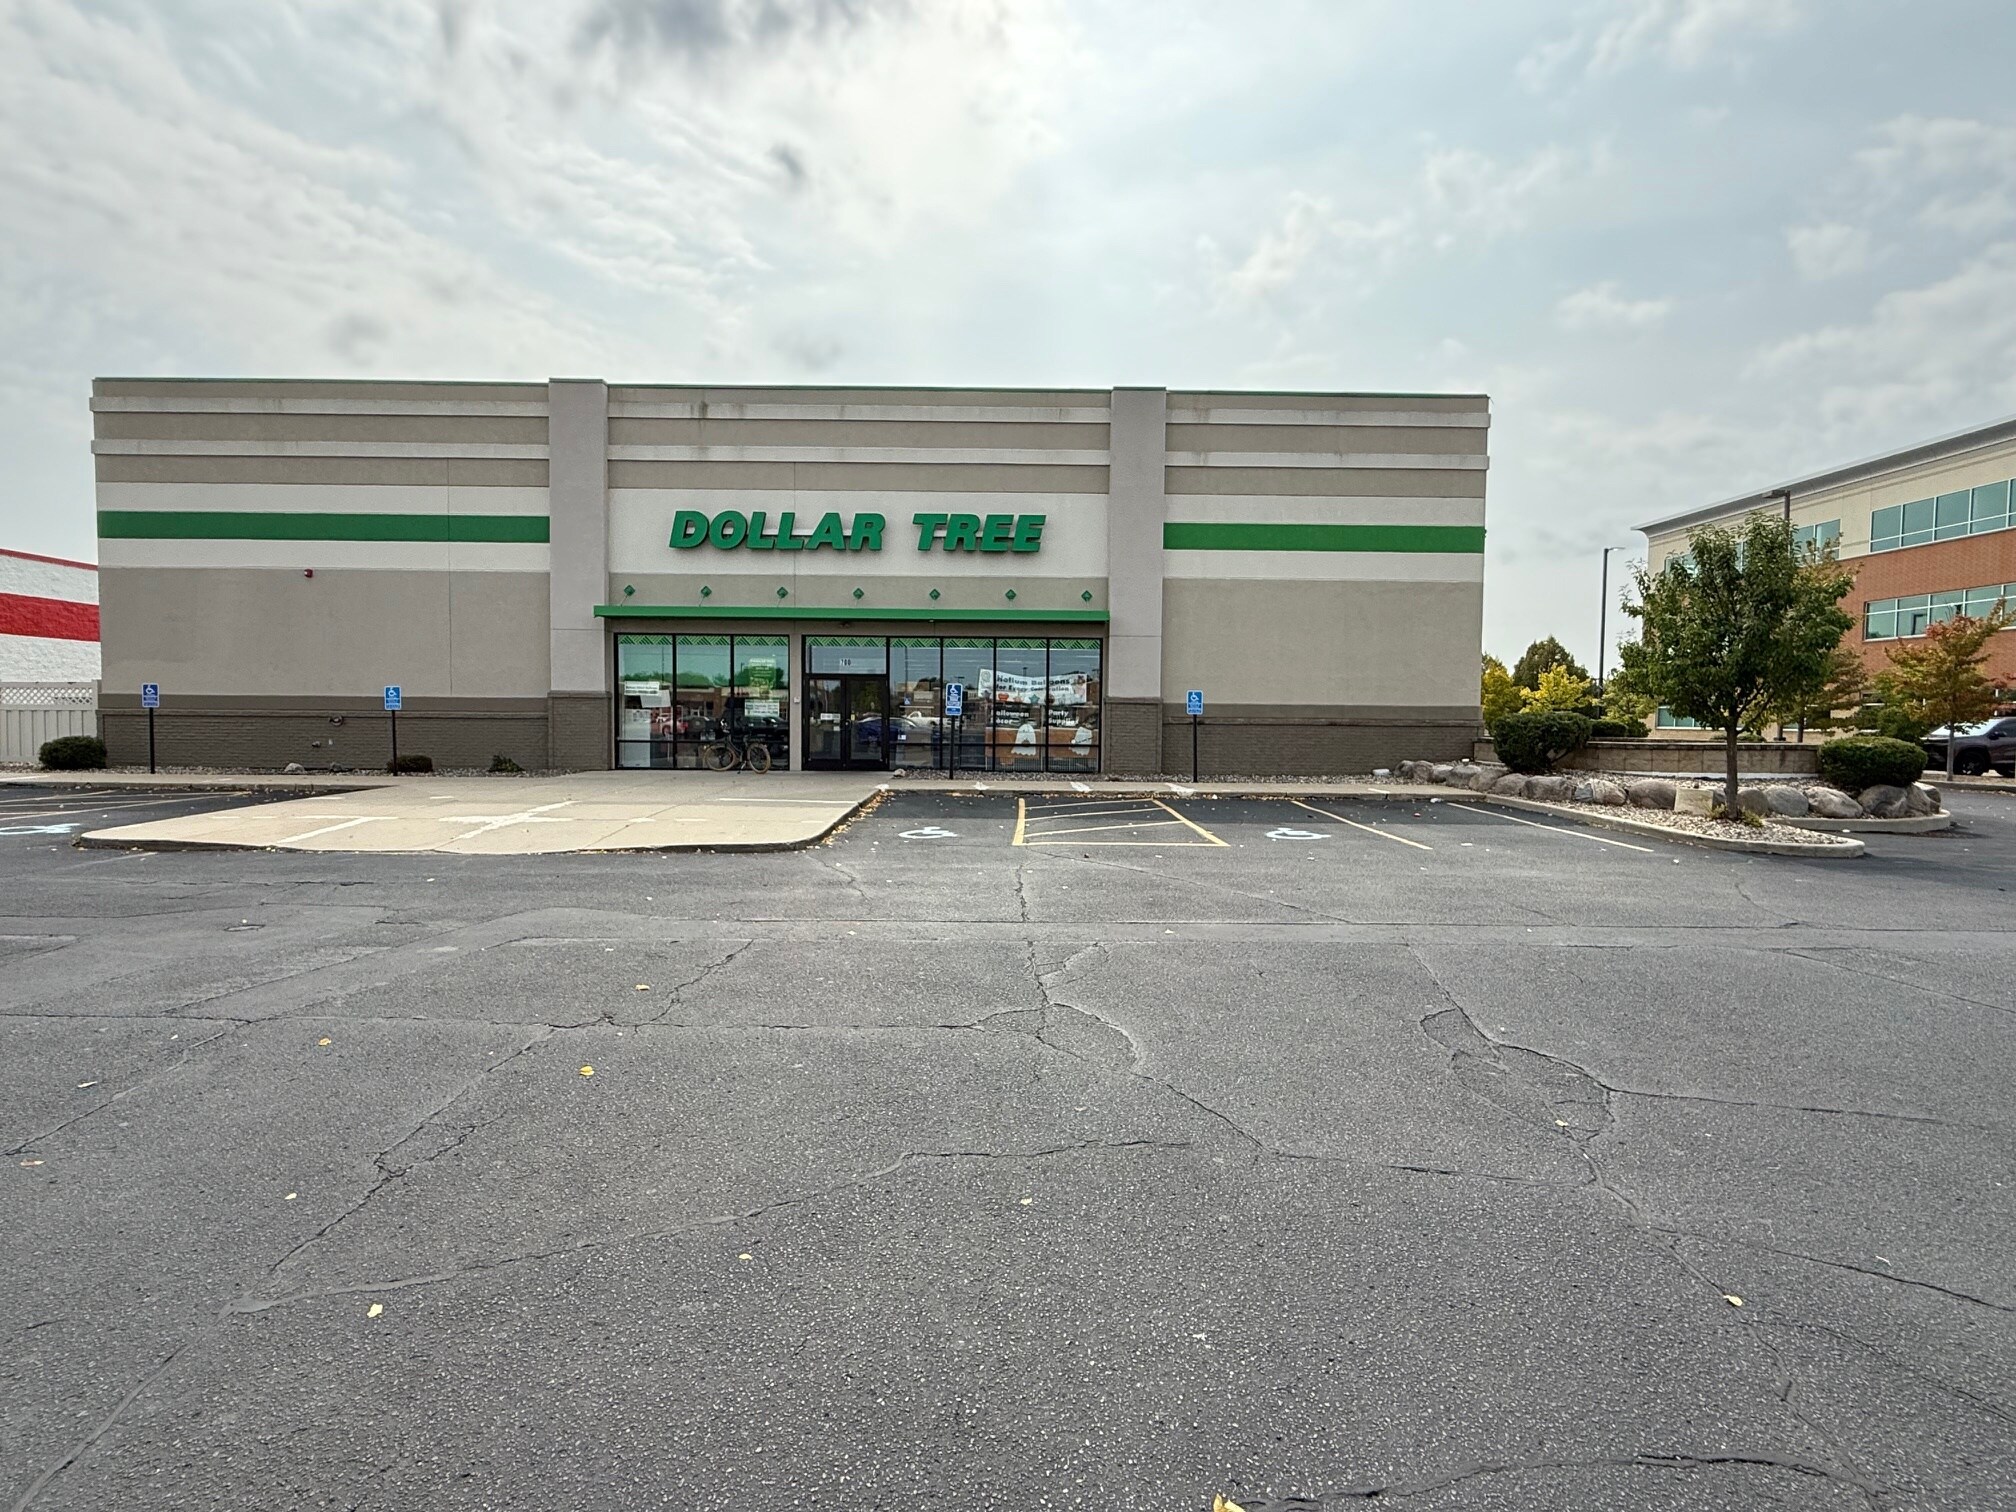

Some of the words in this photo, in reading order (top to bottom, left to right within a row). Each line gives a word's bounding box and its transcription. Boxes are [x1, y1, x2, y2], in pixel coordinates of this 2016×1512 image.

[668, 509, 886, 551] DOLLAR
[912, 512, 1047, 553] TREE
[1031, 678, 1070, 686] Baloons
[1048, 709, 1069, 717] Party
